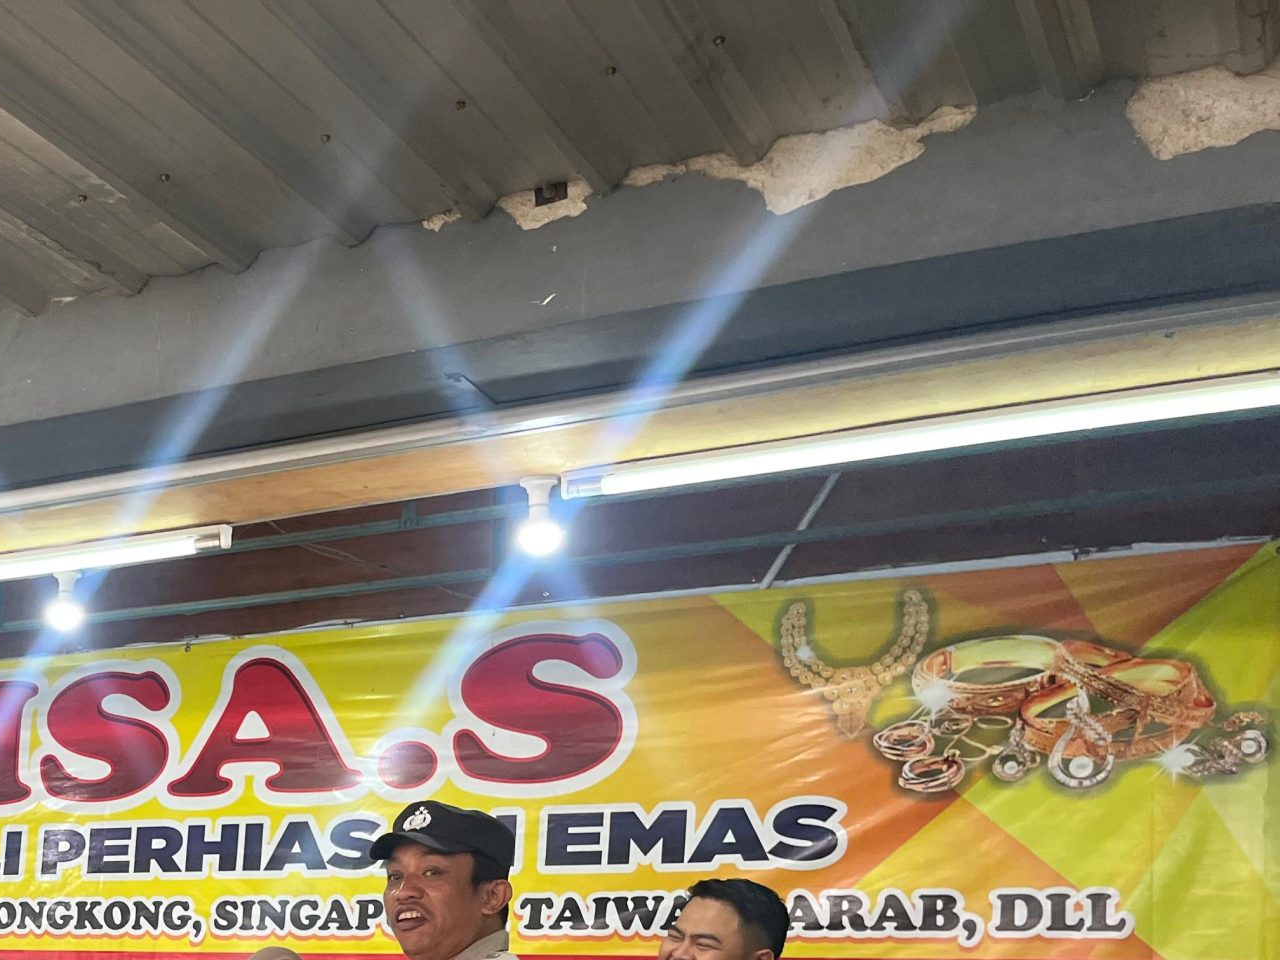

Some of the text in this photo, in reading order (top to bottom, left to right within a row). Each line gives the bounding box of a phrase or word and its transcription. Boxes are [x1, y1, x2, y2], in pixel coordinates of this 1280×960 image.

[41, 814, 518, 876] PERHIAS
[545, 804, 839, 867] EMAS
[213, 898, 385, 932] SINGAP
[787, 892, 977, 942] ARAB,
[994, 892, 1127, 933] DLL
